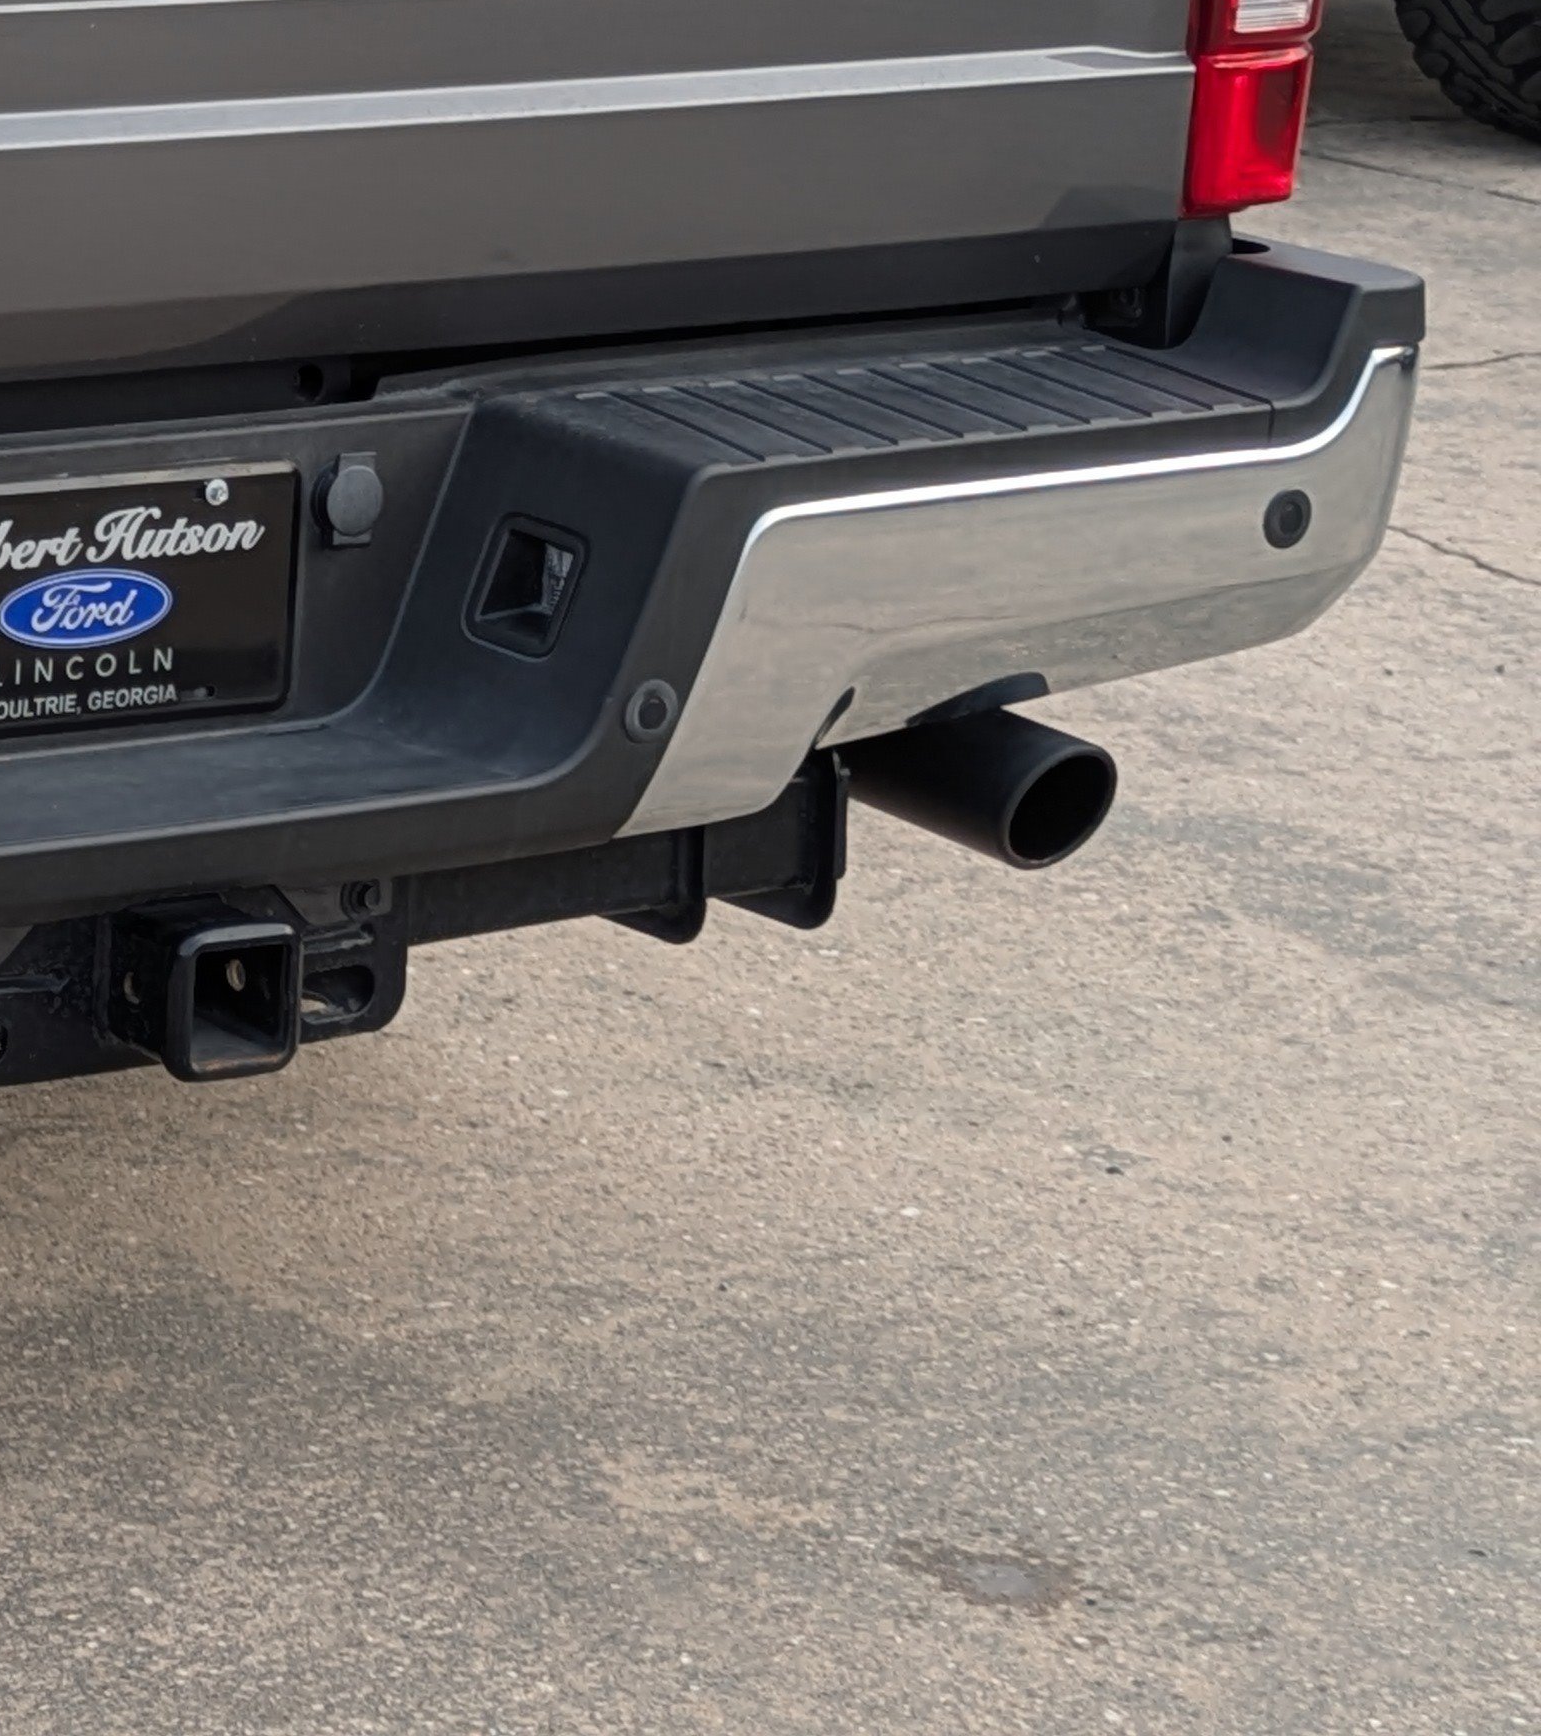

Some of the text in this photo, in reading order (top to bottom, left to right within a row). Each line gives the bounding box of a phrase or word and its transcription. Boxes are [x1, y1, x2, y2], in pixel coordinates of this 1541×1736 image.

[85, 506, 266, 563] Hutson
[30, 580, 139, 634] Ford
[87, 684, 178, 713] GEORGIA
